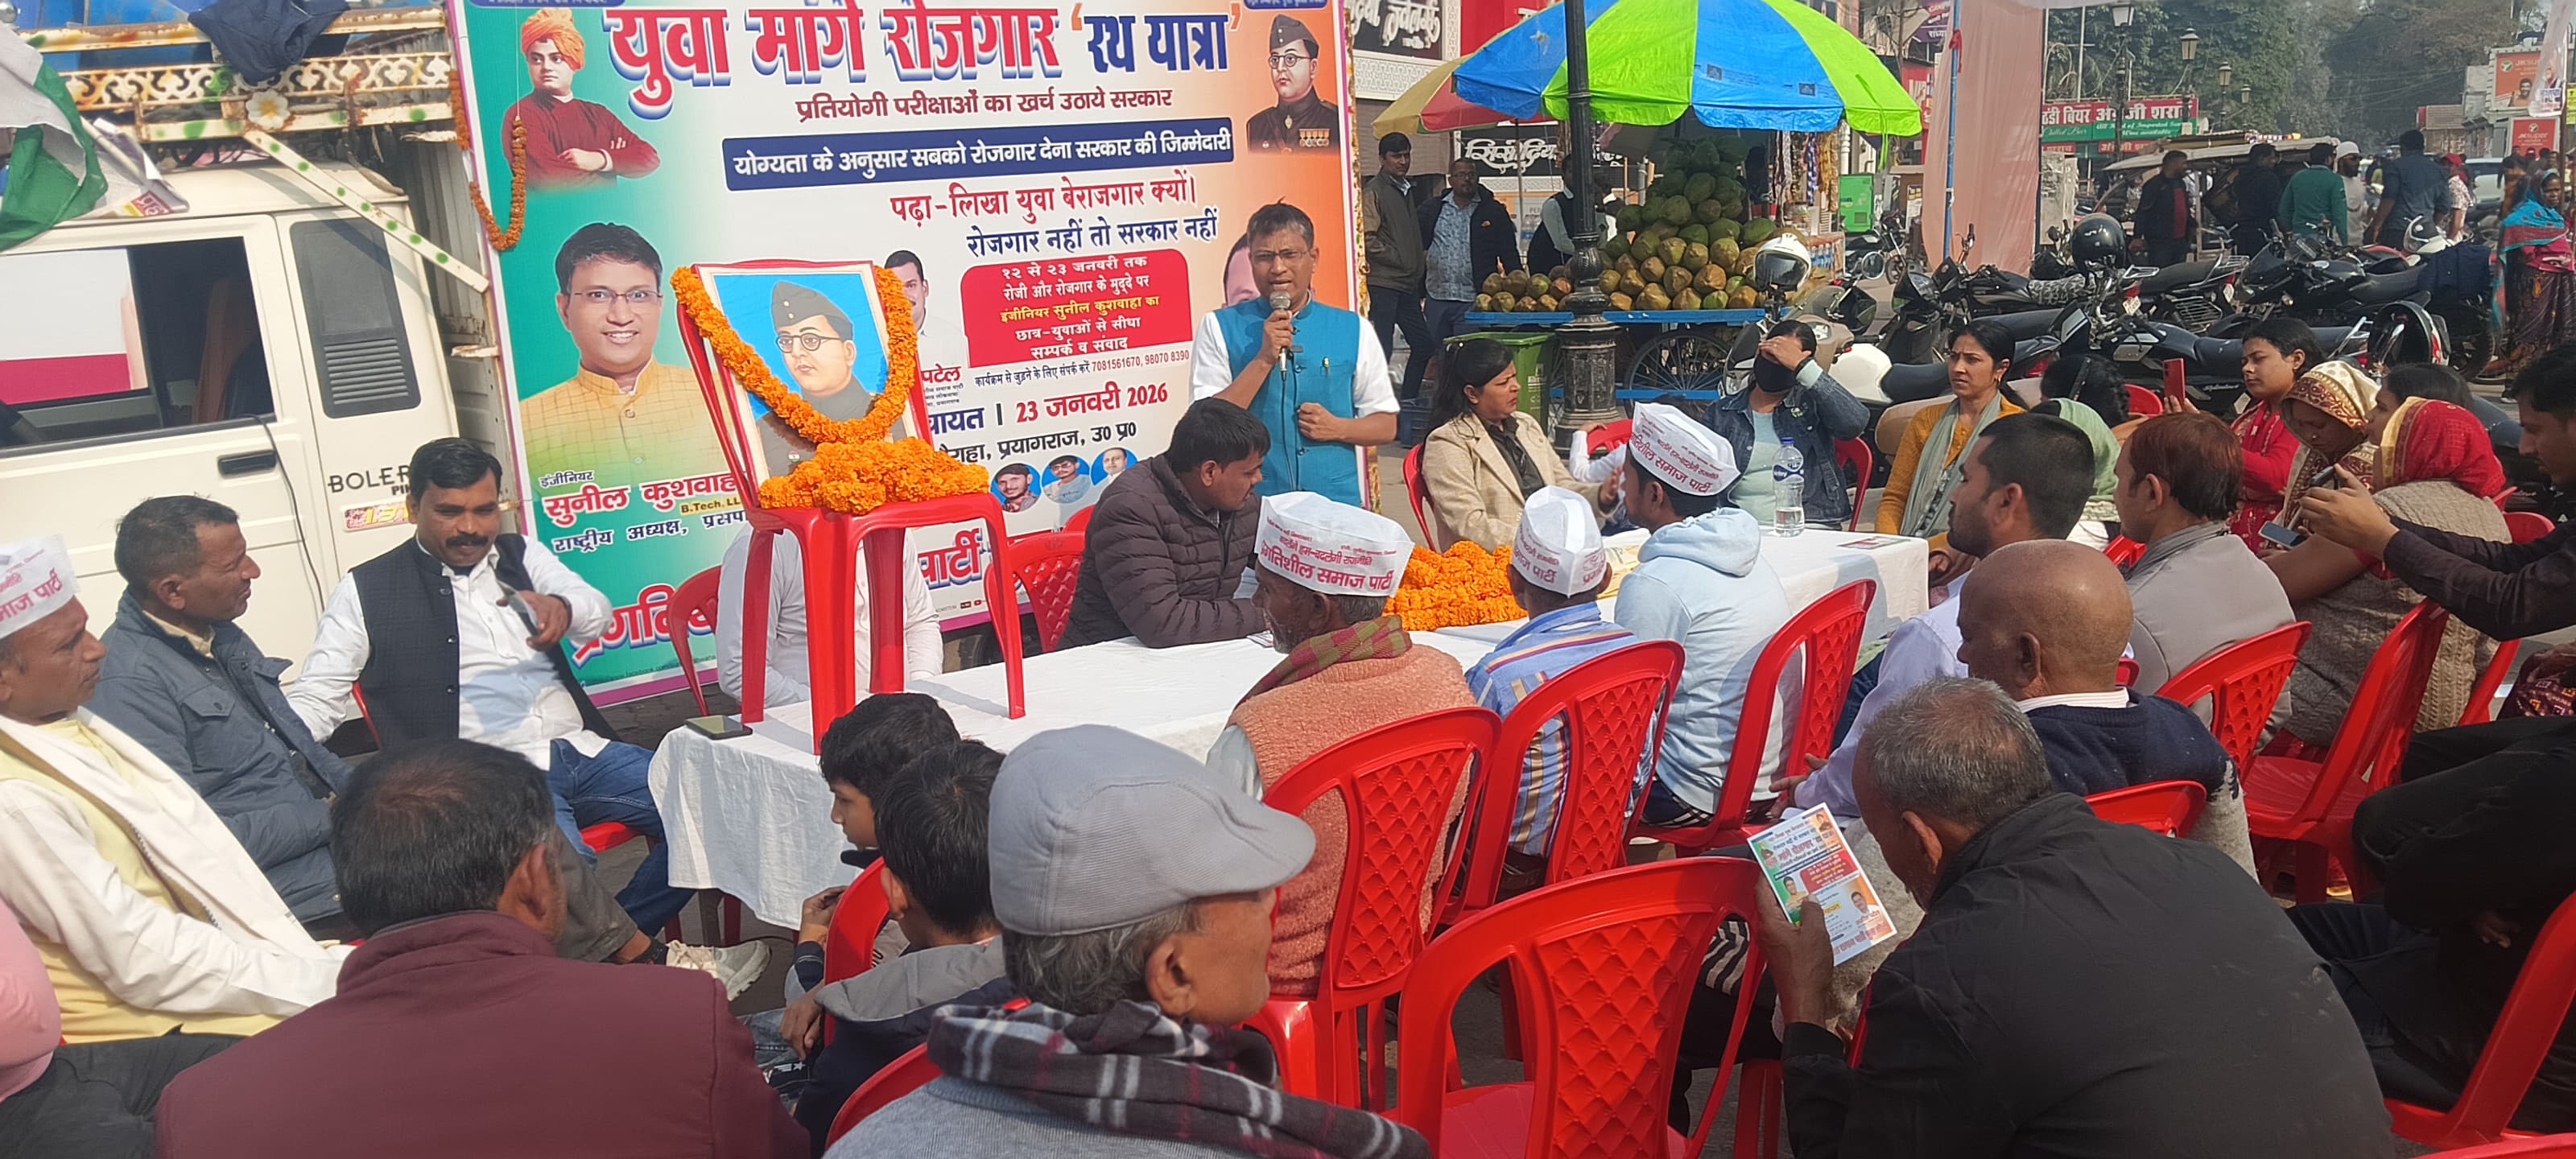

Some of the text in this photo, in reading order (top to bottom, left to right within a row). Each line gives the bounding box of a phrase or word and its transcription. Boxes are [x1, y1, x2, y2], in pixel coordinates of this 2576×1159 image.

[604, 8, 731, 118] युवा
[881, 0, 1062, 81] रोजगार
[795, 86, 1173, 122] प्रतियोगी परीक्षाओं का खर्च उठाये सरकार
[2063, 105, 2091, 125] बियर
[2151, 105, 2192, 120] शरा
[733, 126, 1232, 179] योग्यता के अनुसार सबको रोजगार देना सरकार की जिम्मेदारी
[1015, 188, 1054, 224] युवा
[967, 208, 1218, 257] रोजगार नहीं तो सरकार नहीं
[1002, 256, 1146, 279] १२ से २३ जनवरी तक
[1003, 281, 1028, 301] रोजी
[1032, 280, 1052, 299] और
[1056, 278, 1093, 295] रोजगार
[1096, 275, 1106, 292] के
[1136, 274, 1150, 287] पर
[1000, 295, 1159, 324] इंजीनियर सुनील कुशवाहा का
[1096, 318, 1107, 331] से
[1112, 315, 1141, 331] सीधा
[1030, 334, 1128, 361] सम्पर्क व संवाद
[921, 363, 962, 384] पटेल
[975, 370, 1003, 387] कार्यक्रम
[1005, 369, 1013, 384] से
[1034, 367, 1041, 380] के
[1042, 364, 1059, 380] लिए
[1060, 361, 1078, 377] संपर्क
[1079, 360, 1092, 373] करें
[1092, 357, 1143, 373] 7081561670,
[1145, 353, 1169, 365] 98070
[1170, 349, 1190, 362] 8390
[1016, 401, 1038, 423] 23
[1044, 381, 1121, 417] जनवरी
[1127, 382, 1168, 407] 2026
[997, 431, 1086, 460] प्रयागराज,
[328, 464, 411, 493] BOLER
[540, 472, 594, 488] इंजीनियर
[1654, 456, 1689, 484] समाज
[545, 485, 629, 525] सुनील
[554, 529, 613, 552] राष्ट्रीय
[1317, 567, 1366, 589] समाज
